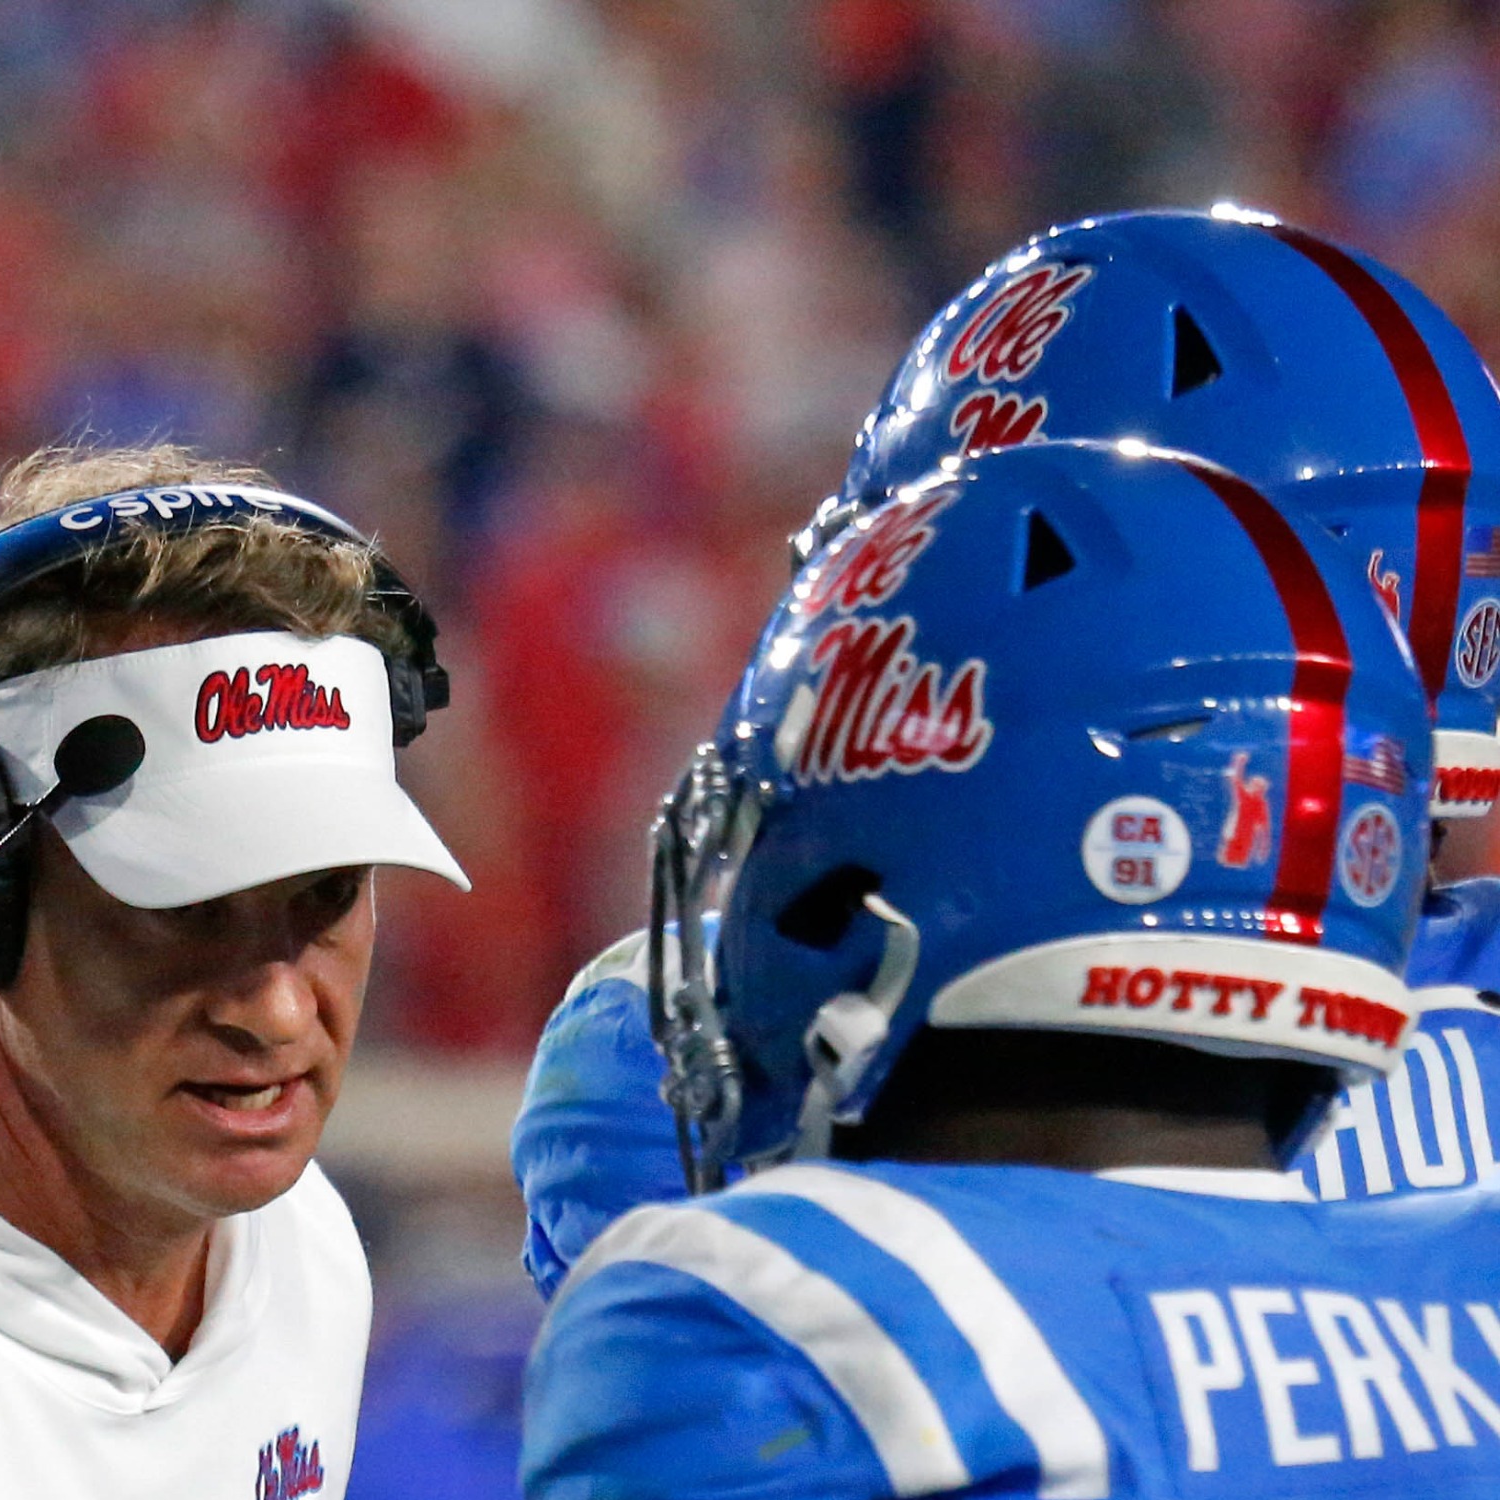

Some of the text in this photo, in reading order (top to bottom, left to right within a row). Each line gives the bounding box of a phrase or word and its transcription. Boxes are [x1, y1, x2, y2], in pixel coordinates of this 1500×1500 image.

[942, 263, 1093, 384] Ole
[802, 488, 966, 615] Ole
[195, 663, 350, 744] Ole Miss
[796, 614, 994, 786] Miss
[1111, 812, 1164, 844] CA
[1112, 856, 1158, 888] 91
[1080, 966, 1285, 1021] HOTTY
